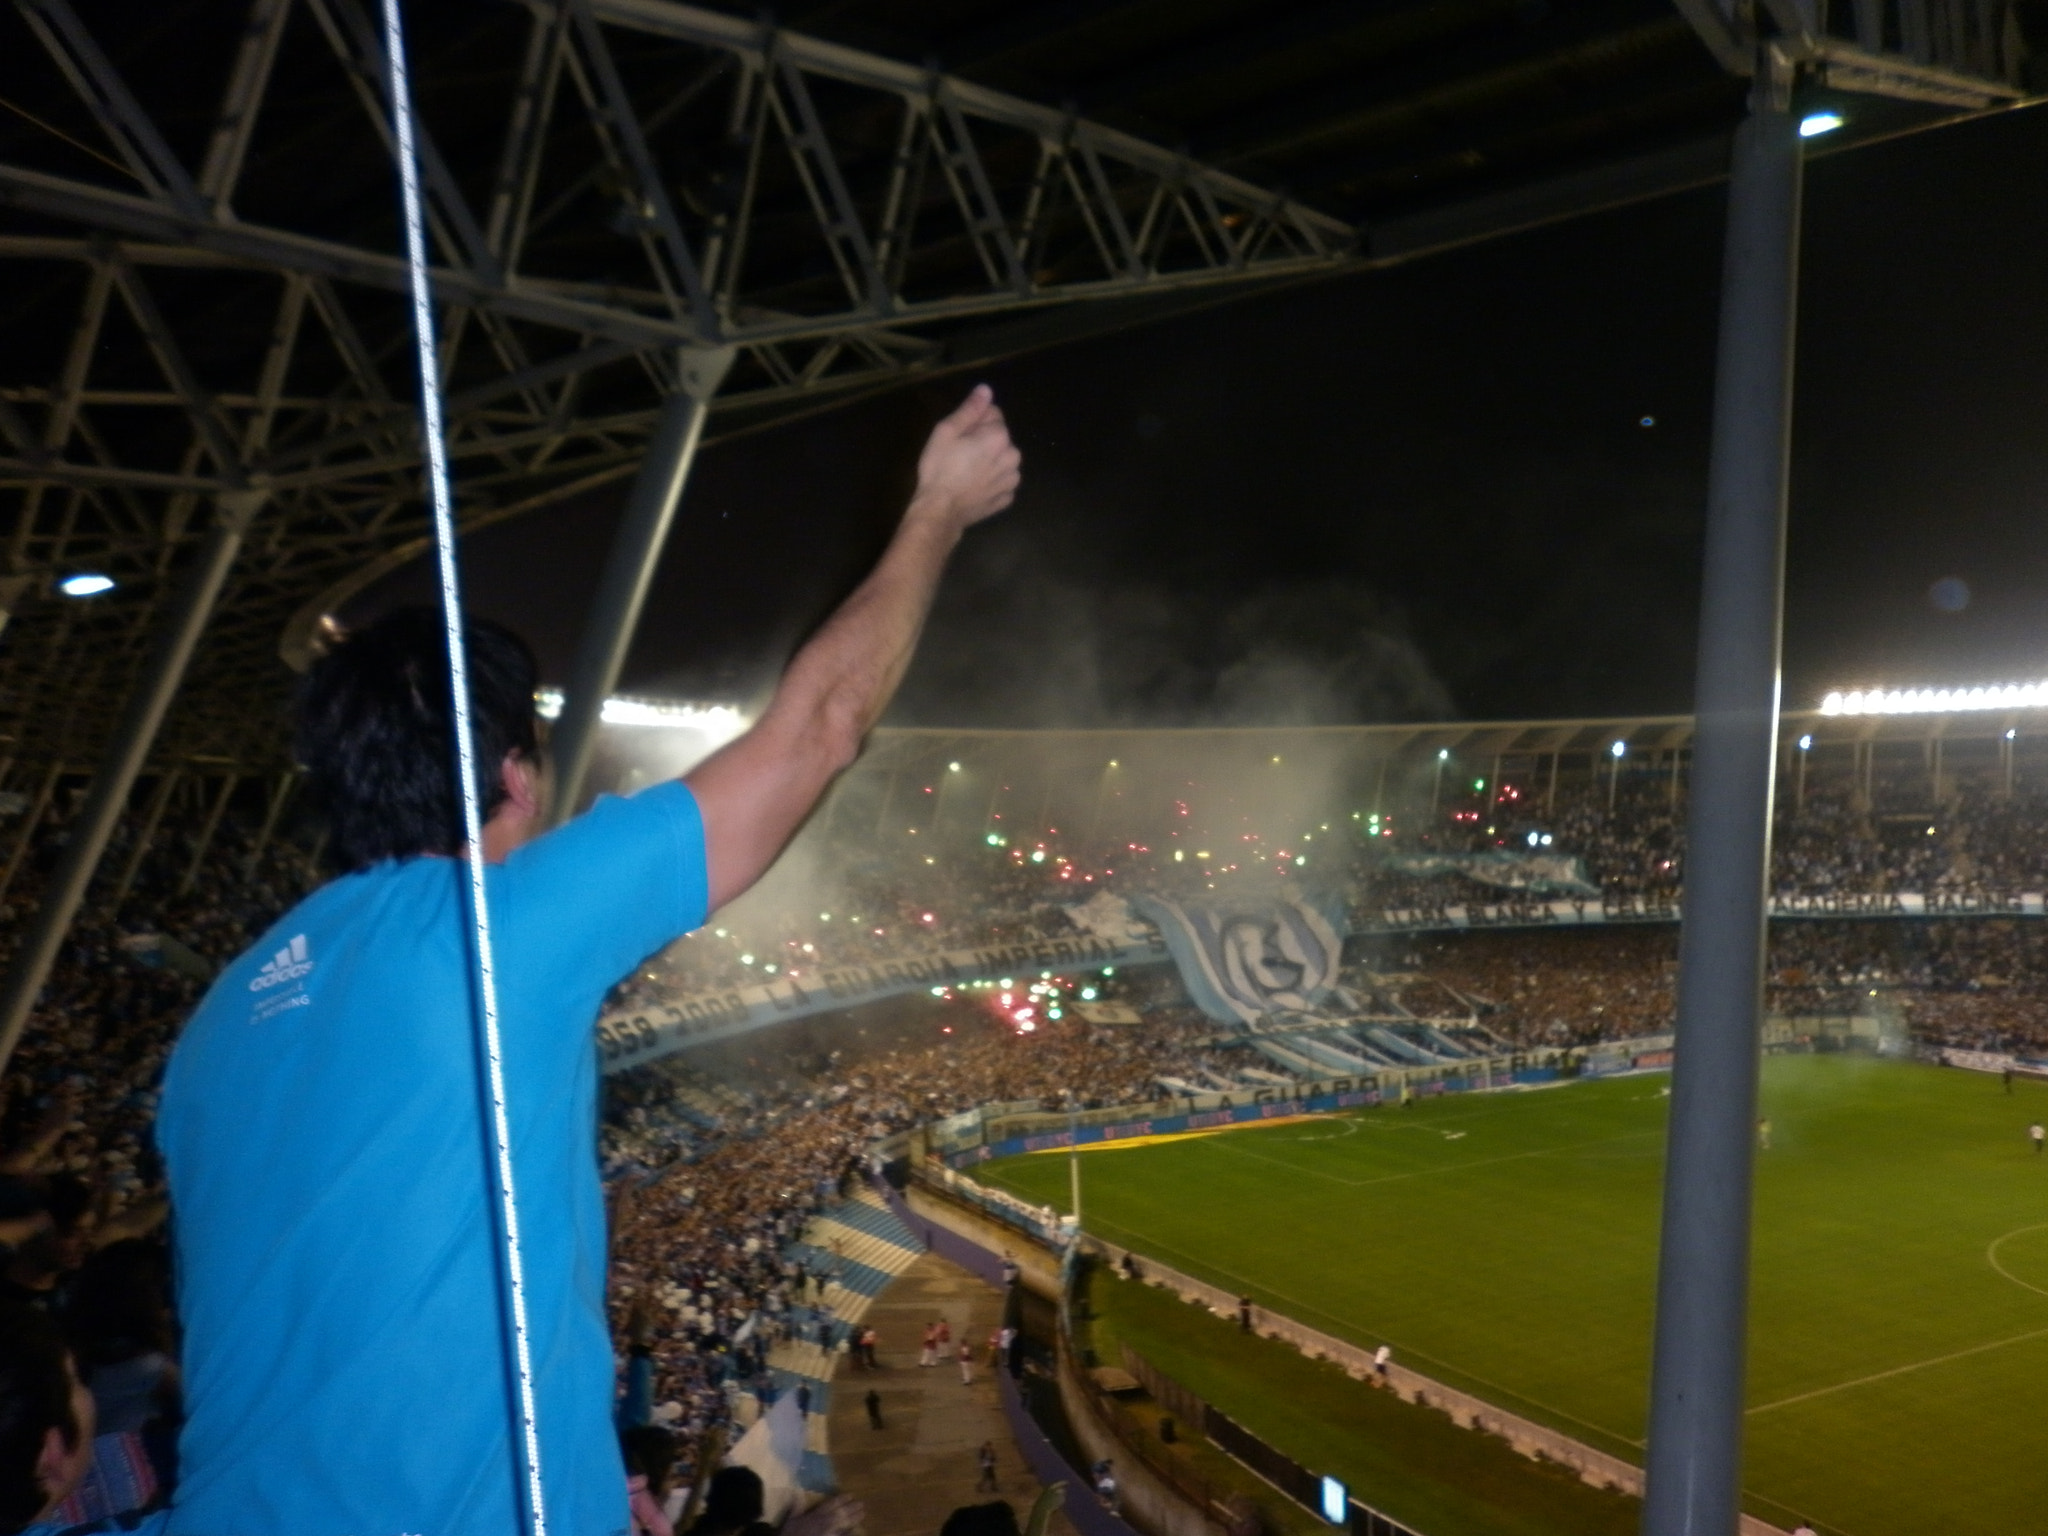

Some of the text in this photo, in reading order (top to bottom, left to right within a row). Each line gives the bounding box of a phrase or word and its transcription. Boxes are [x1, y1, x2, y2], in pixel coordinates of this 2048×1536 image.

[1572, 899, 1585, 921] Y
[764, 980, 811, 1011] LA
[822, 956, 961, 998] GUARDIA
[973, 938, 1127, 974] IMPERIAL
